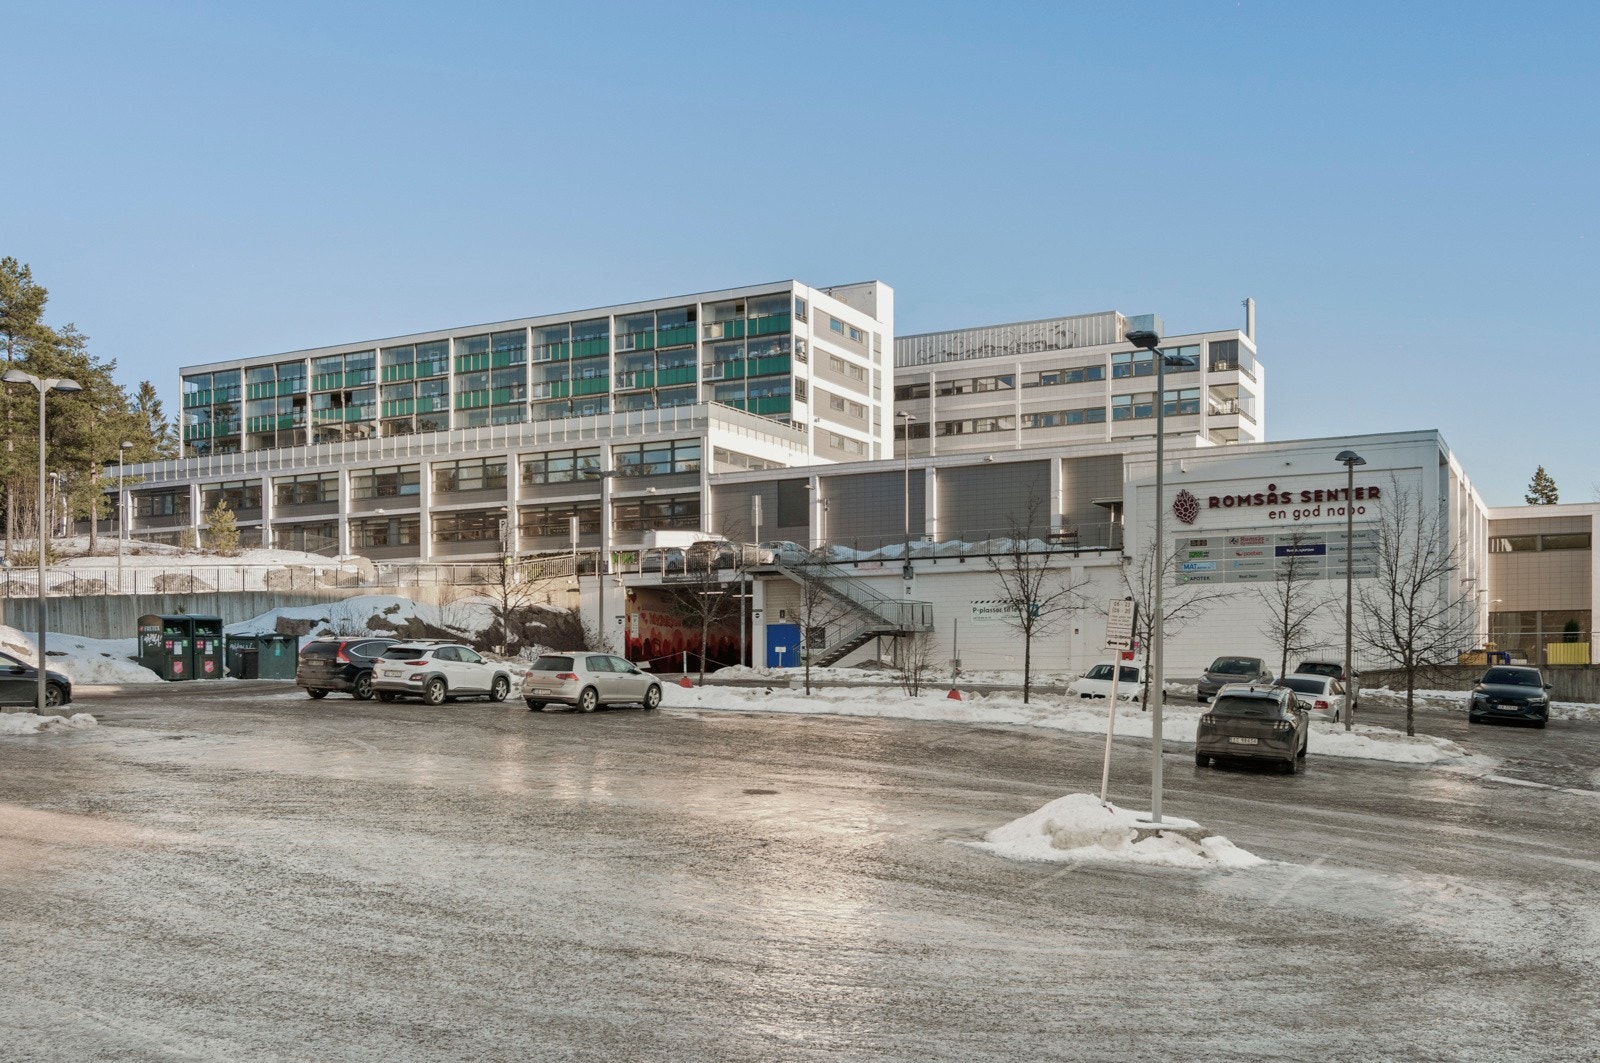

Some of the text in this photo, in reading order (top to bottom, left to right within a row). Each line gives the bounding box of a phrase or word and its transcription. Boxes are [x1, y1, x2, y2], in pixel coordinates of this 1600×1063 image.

[1209, 483, 1381, 508] ROMSÅS SENTER
[1268, 509, 1287, 519] en
[1293, 505, 1321, 521] god
